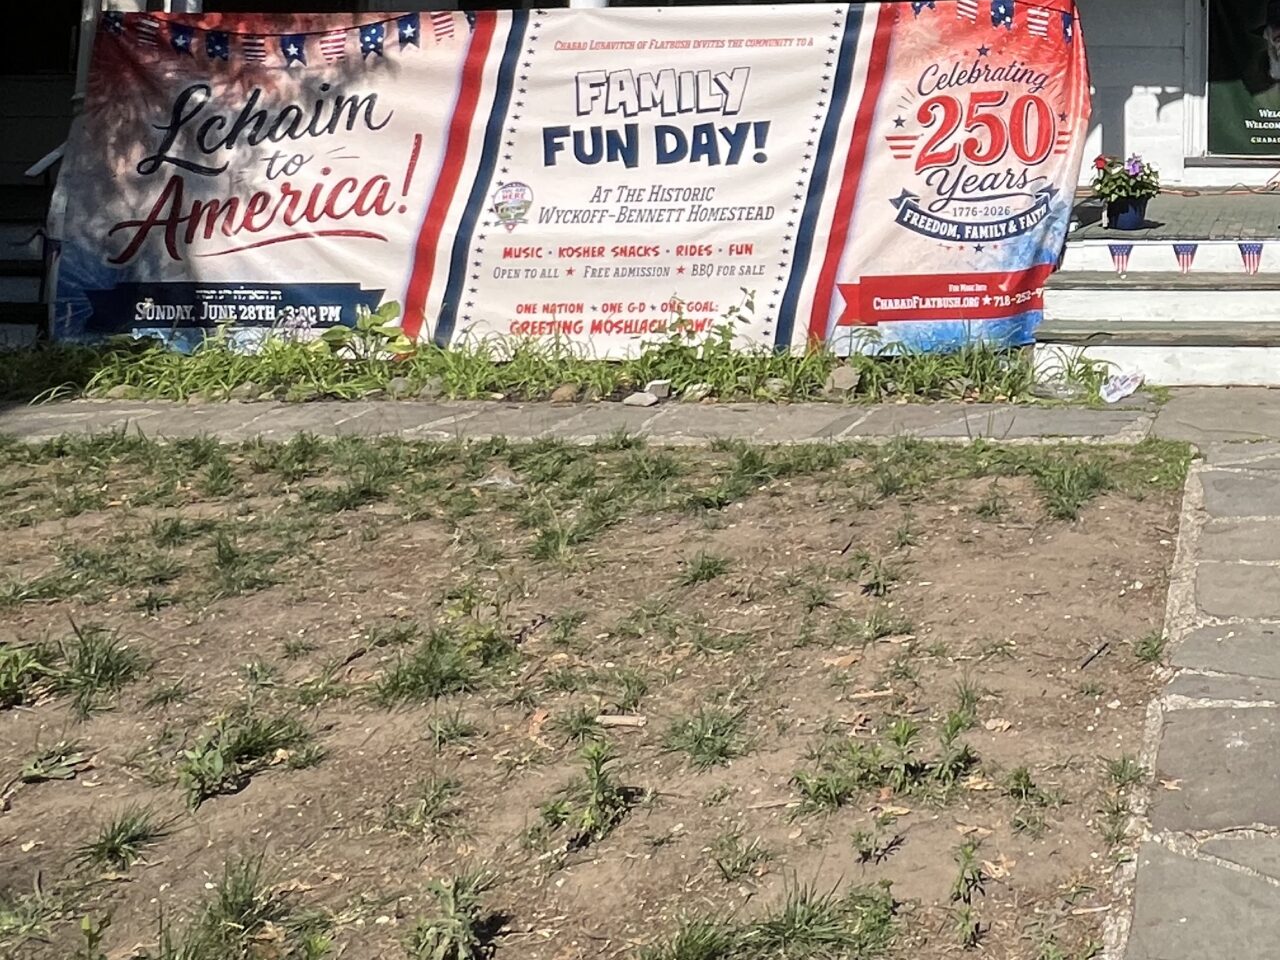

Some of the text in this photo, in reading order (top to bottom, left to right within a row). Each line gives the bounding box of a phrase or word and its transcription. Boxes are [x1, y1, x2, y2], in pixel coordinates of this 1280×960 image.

[589, 40, 635, 50] LUBAVITCH
[636, 40, 648, 50] OF
[728, 39, 743, 48] THE
[796, 38, 806, 46] TO
[808, 38, 814, 46] A
[918, 60, 1050, 96] Celebrating
[576, 66, 750, 117] FAMILY
[914, 90, 1054, 174] 250
[542, 120, 771, 169] FUN DAY!
[263, 149, 314, 181] to
[590, 184, 716, 203] AT THE HISTORIC
[926, 164, 1047, 212] Years
[107, 133, 422, 264] America!
[538, 204, 775, 224] WYCKOFF-BENNETT HOMESTEAD
[903, 204, 1047, 239] FREEDOM, FAMILY & FAITH
[952, 206, 1010, 217] 1776-2026
[503, 244, 754, 258] MUSIC KOSHER SNACKS RIDES FUN
[493, 264, 766, 280] OPEN TO ALL FREE ADMISSION BBQ FOR SALE
[134, 302, 196, 322] SUNDAY,
[200, 302, 236, 320] JUNE
[240, 304, 276, 320] 28TH
[320, 305, 342, 322] PM
[516, 304, 537, 314] ONE
[542, 303, 584, 314] NATION
[602, 302, 623, 312] ONE
[628, 302, 646, 312] G-D
[686, 301, 718, 312] GOAL:
[510, 319, 584, 335] GREETING
[590, 319, 667, 334] MOSHIACH
